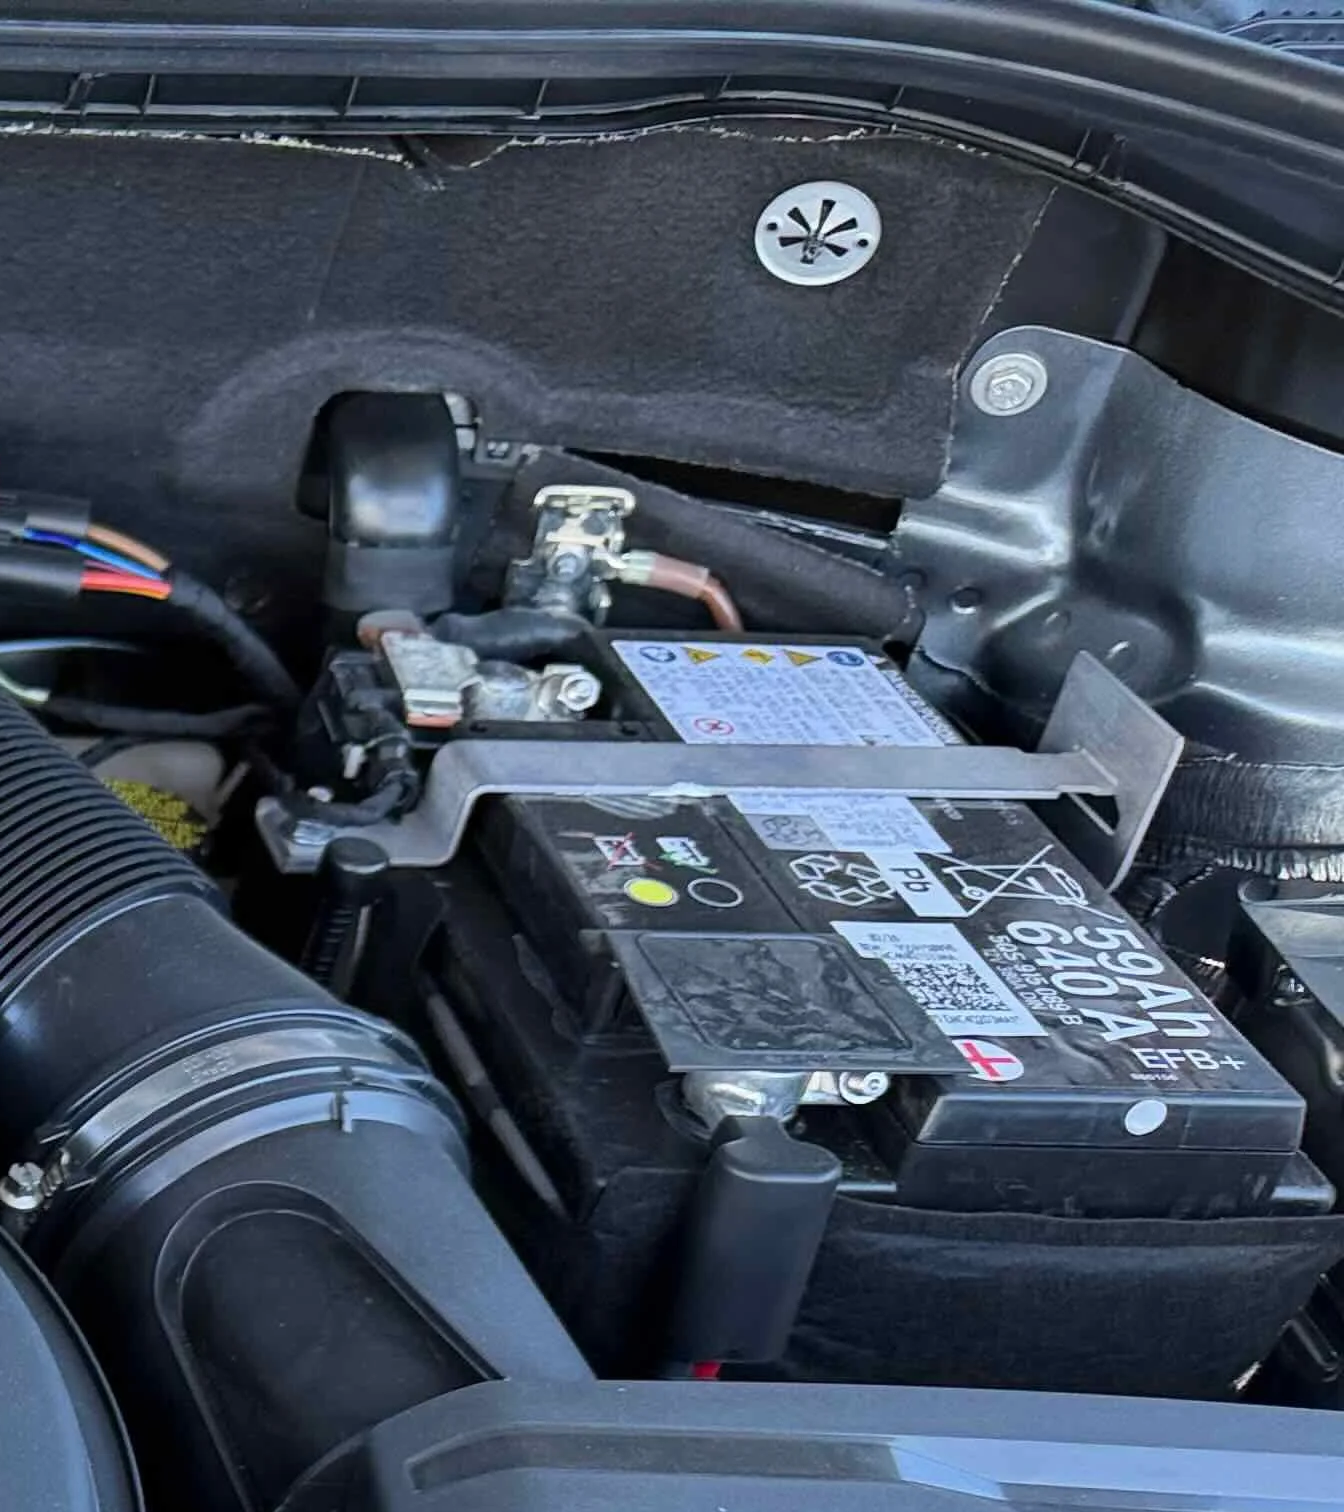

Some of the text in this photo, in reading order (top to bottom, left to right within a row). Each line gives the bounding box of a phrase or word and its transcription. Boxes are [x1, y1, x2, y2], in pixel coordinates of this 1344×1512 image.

[889, 866, 930, 895] Pb
[1006, 920, 1120, 997] 640
[1079, 1006, 1159, 1043] A
[1073, 925, 1215, 1038] 59Ah
[1130, 1047, 1246, 1072] EFB+
